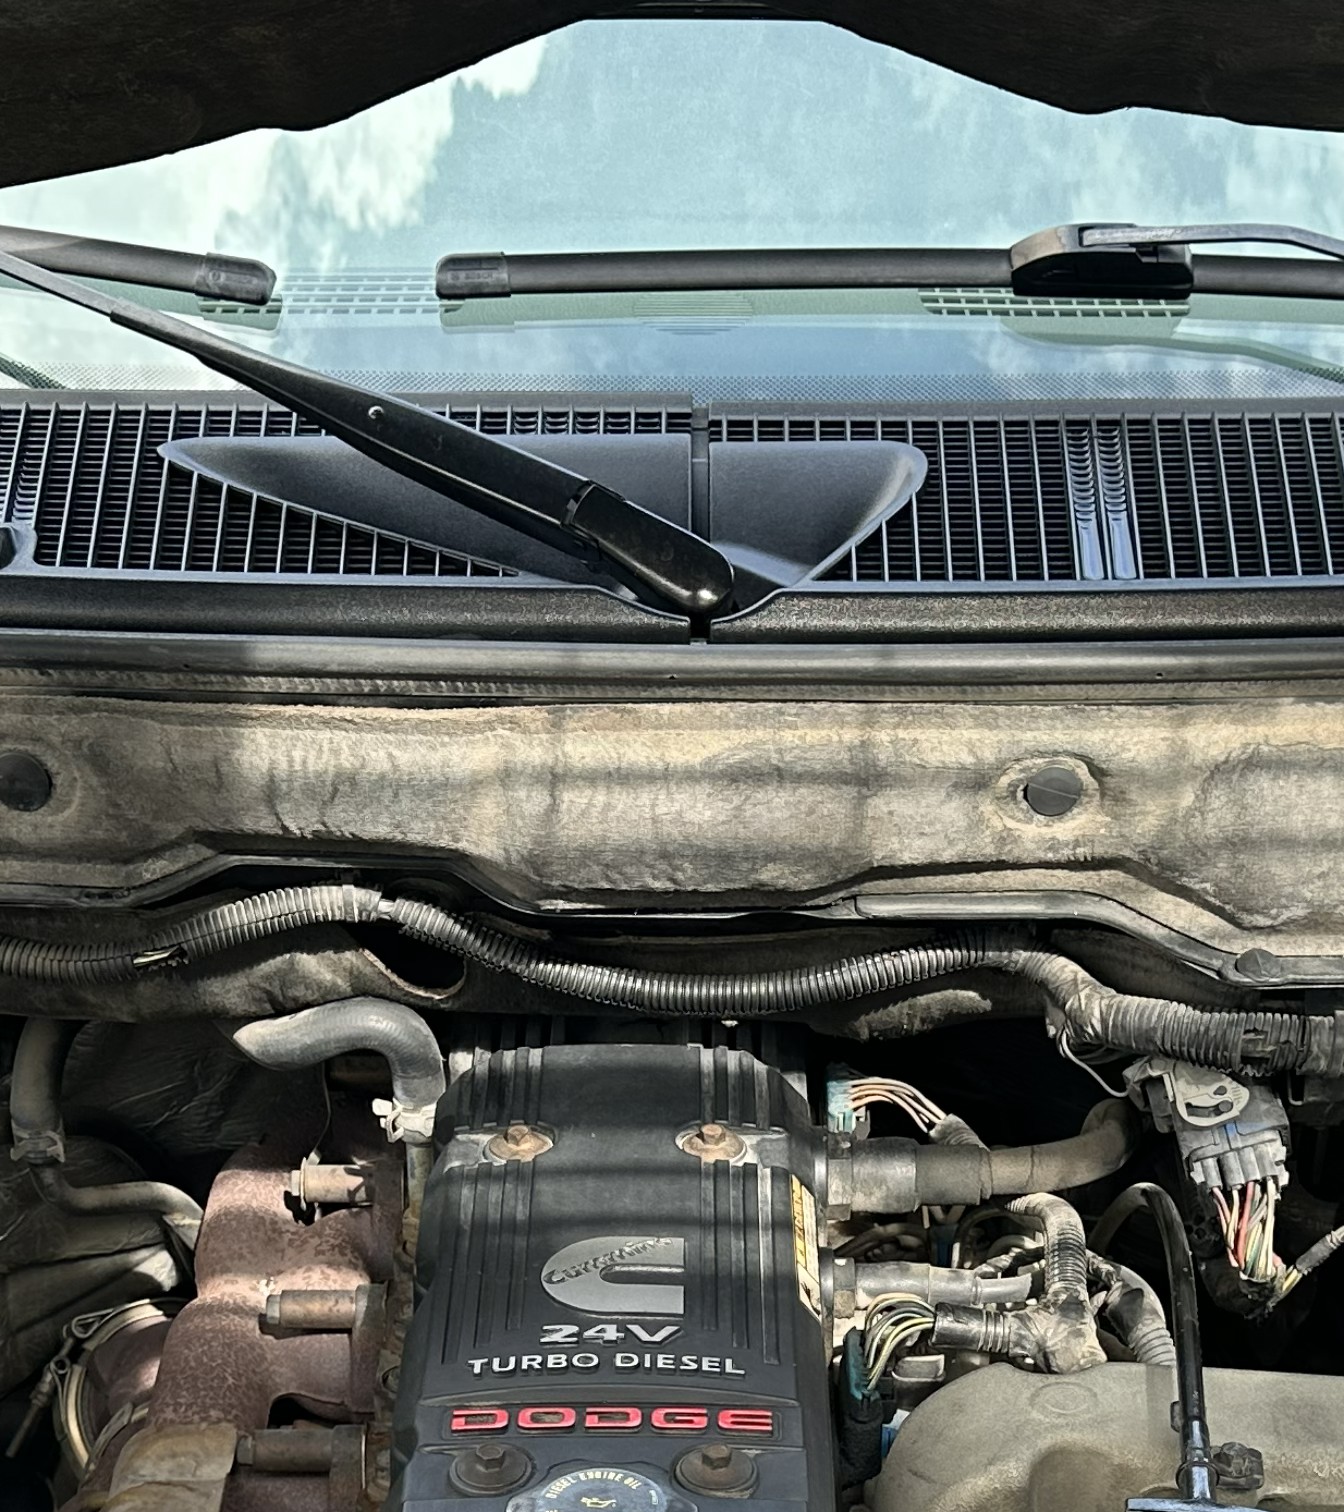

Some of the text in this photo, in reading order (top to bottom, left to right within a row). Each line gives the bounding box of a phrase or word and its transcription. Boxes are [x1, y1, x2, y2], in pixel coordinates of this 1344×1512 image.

[543, 1236, 673, 1284] Cummins
[539, 1323, 681, 1345] 24V
[467, 1352, 746, 1376] TURBO DIESEL
[450, 1407, 773, 1432] DODGE
[545, 1471, 642, 1500] DIESEL ENGINE OIL
